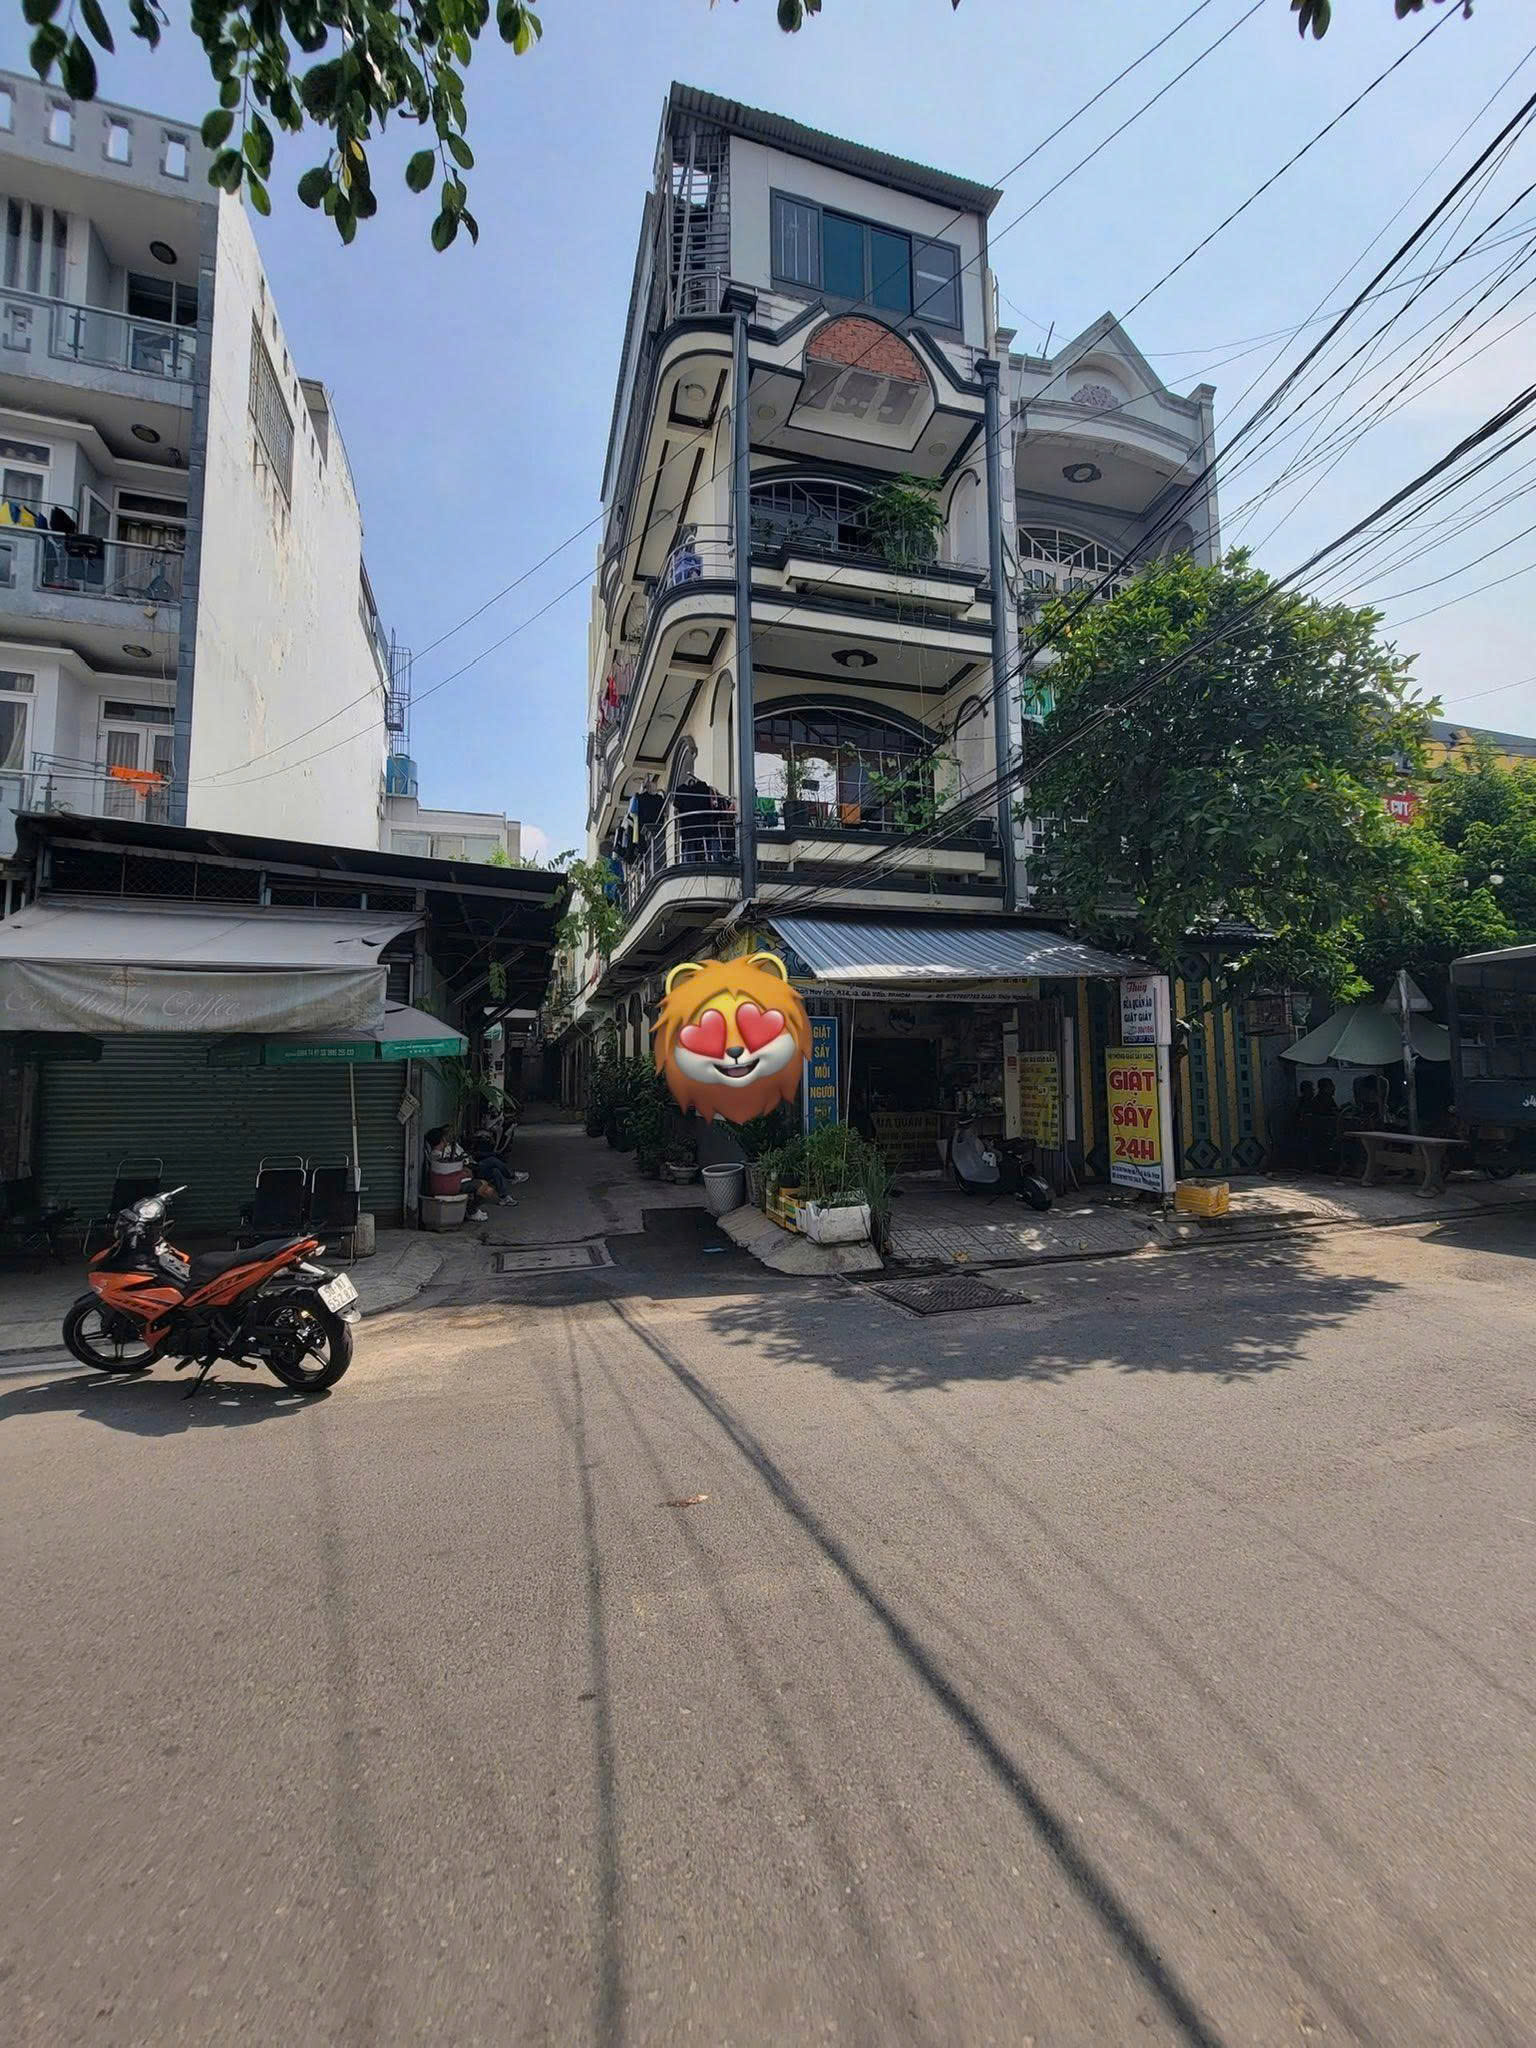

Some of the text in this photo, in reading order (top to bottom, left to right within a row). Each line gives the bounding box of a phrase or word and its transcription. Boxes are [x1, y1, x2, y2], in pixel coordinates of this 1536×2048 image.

[161, 989, 241, 1021] Coffee
[813, 1024, 832, 1041] GIẶT
[814, 1042, 830, 1058] SẤY
[1109, 1066, 1155, 1096] GIẶT
[1112, 1099, 1153, 1128] SẤY
[1114, 1136, 1155, 1161] 24H
